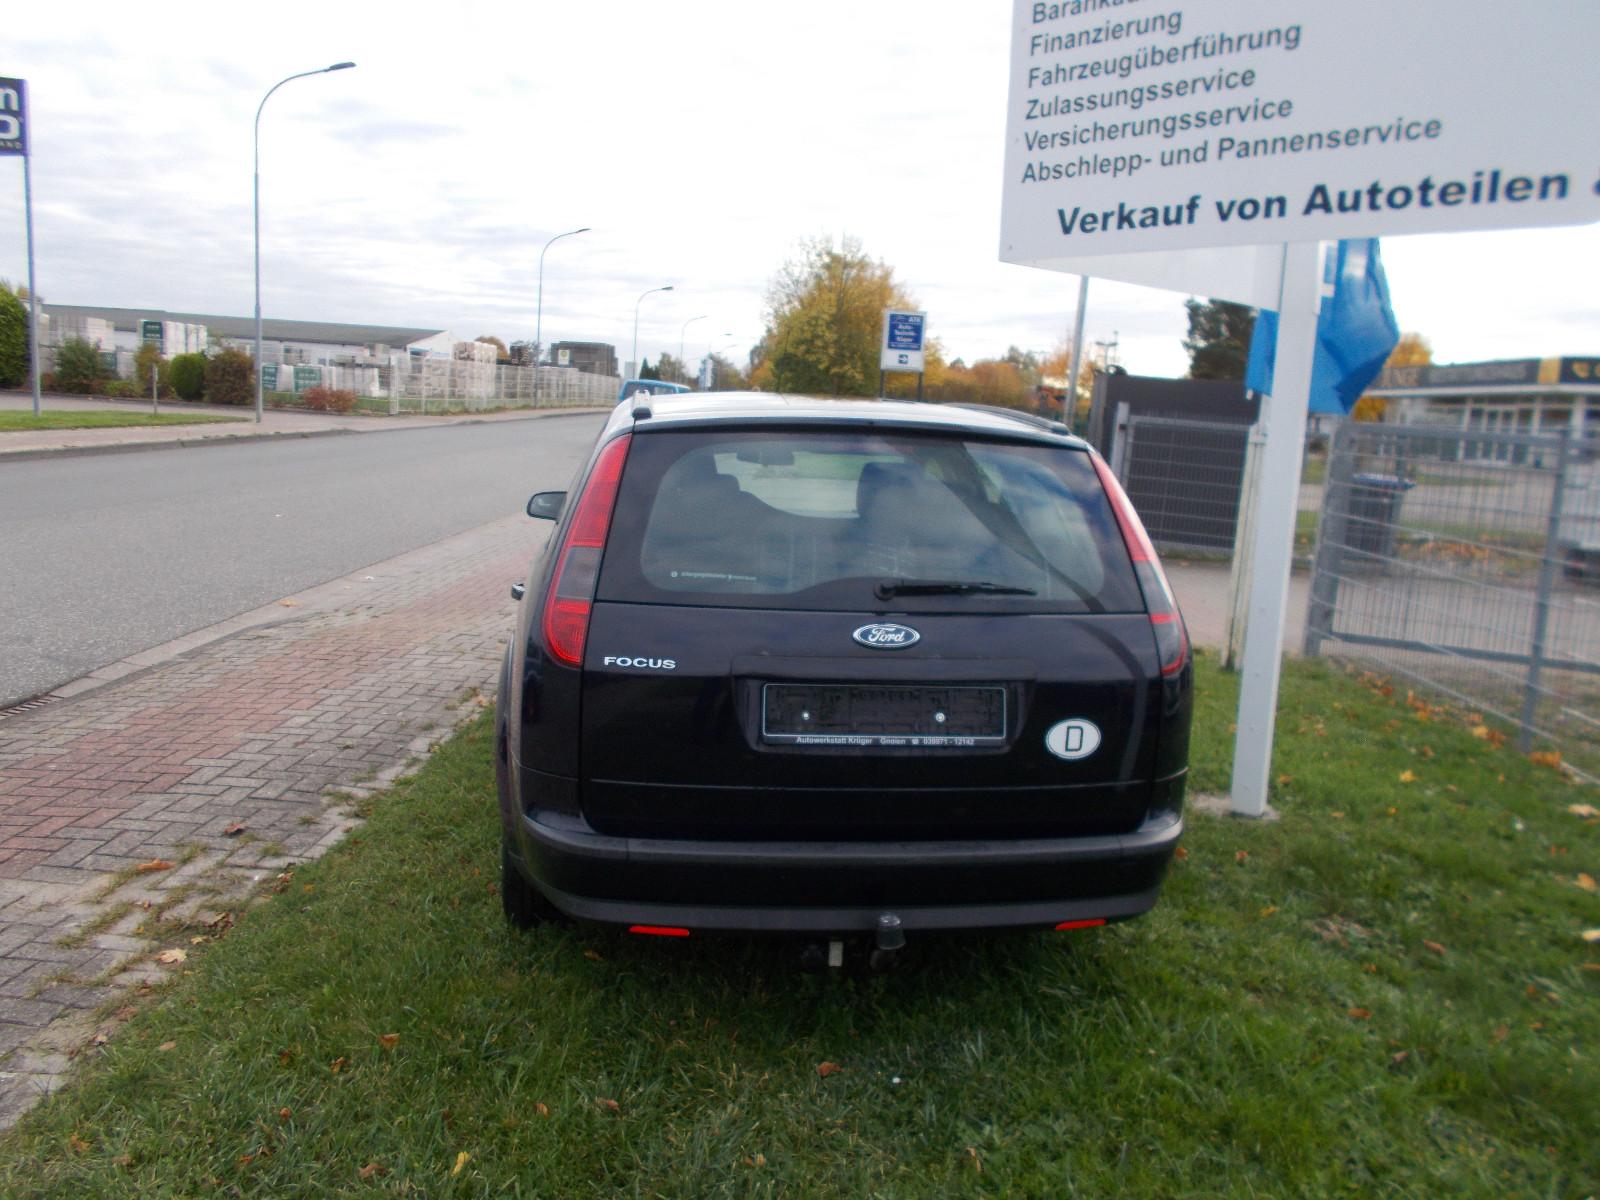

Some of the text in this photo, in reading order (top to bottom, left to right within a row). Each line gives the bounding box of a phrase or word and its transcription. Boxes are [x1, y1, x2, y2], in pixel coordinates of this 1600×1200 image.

[1028, 24, 1302, 88] Fahrzeugüberführung
[1030, 9, 1182, 56] Finanzierung
[1025, 67, 1256, 121] Zulassungsservice
[1021, 117, 1443, 183] Abschlepp- und Pannenservice
[1024, 97, 1294, 152] Versicherungsservice
[1056, 195, 1200, 235] Verkauf
[1215, 193, 1287, 223] von
[1302, 169, 1569, 216] Autoteilen
[869, 628, 906, 642] Ford
[603, 656, 676, 669] FOCUS
[1065, 725, 1084, 752] D
